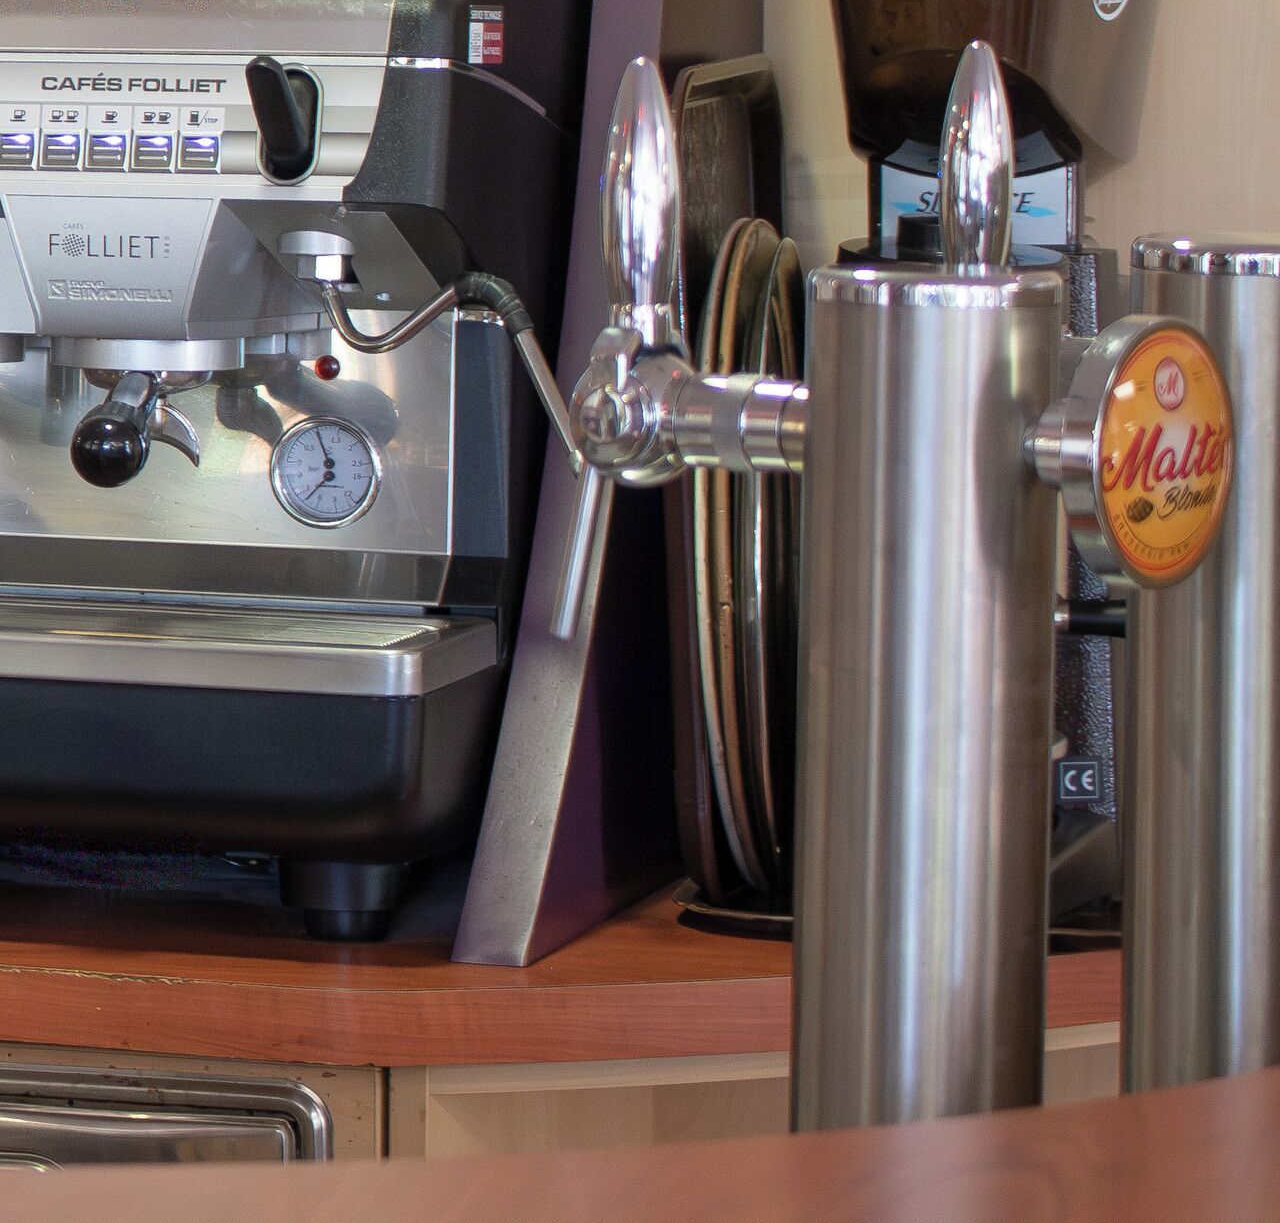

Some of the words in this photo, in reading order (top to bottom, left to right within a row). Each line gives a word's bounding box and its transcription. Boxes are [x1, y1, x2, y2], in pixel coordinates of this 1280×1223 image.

[41, 72, 122, 92] CAFÉS
[127, 78, 227, 93] FOLLIET
[62, 221, 84, 230] CAFÉS
[68, 287, 173, 303] SIMONELLI
[1064, 769, 1095, 792] CE
